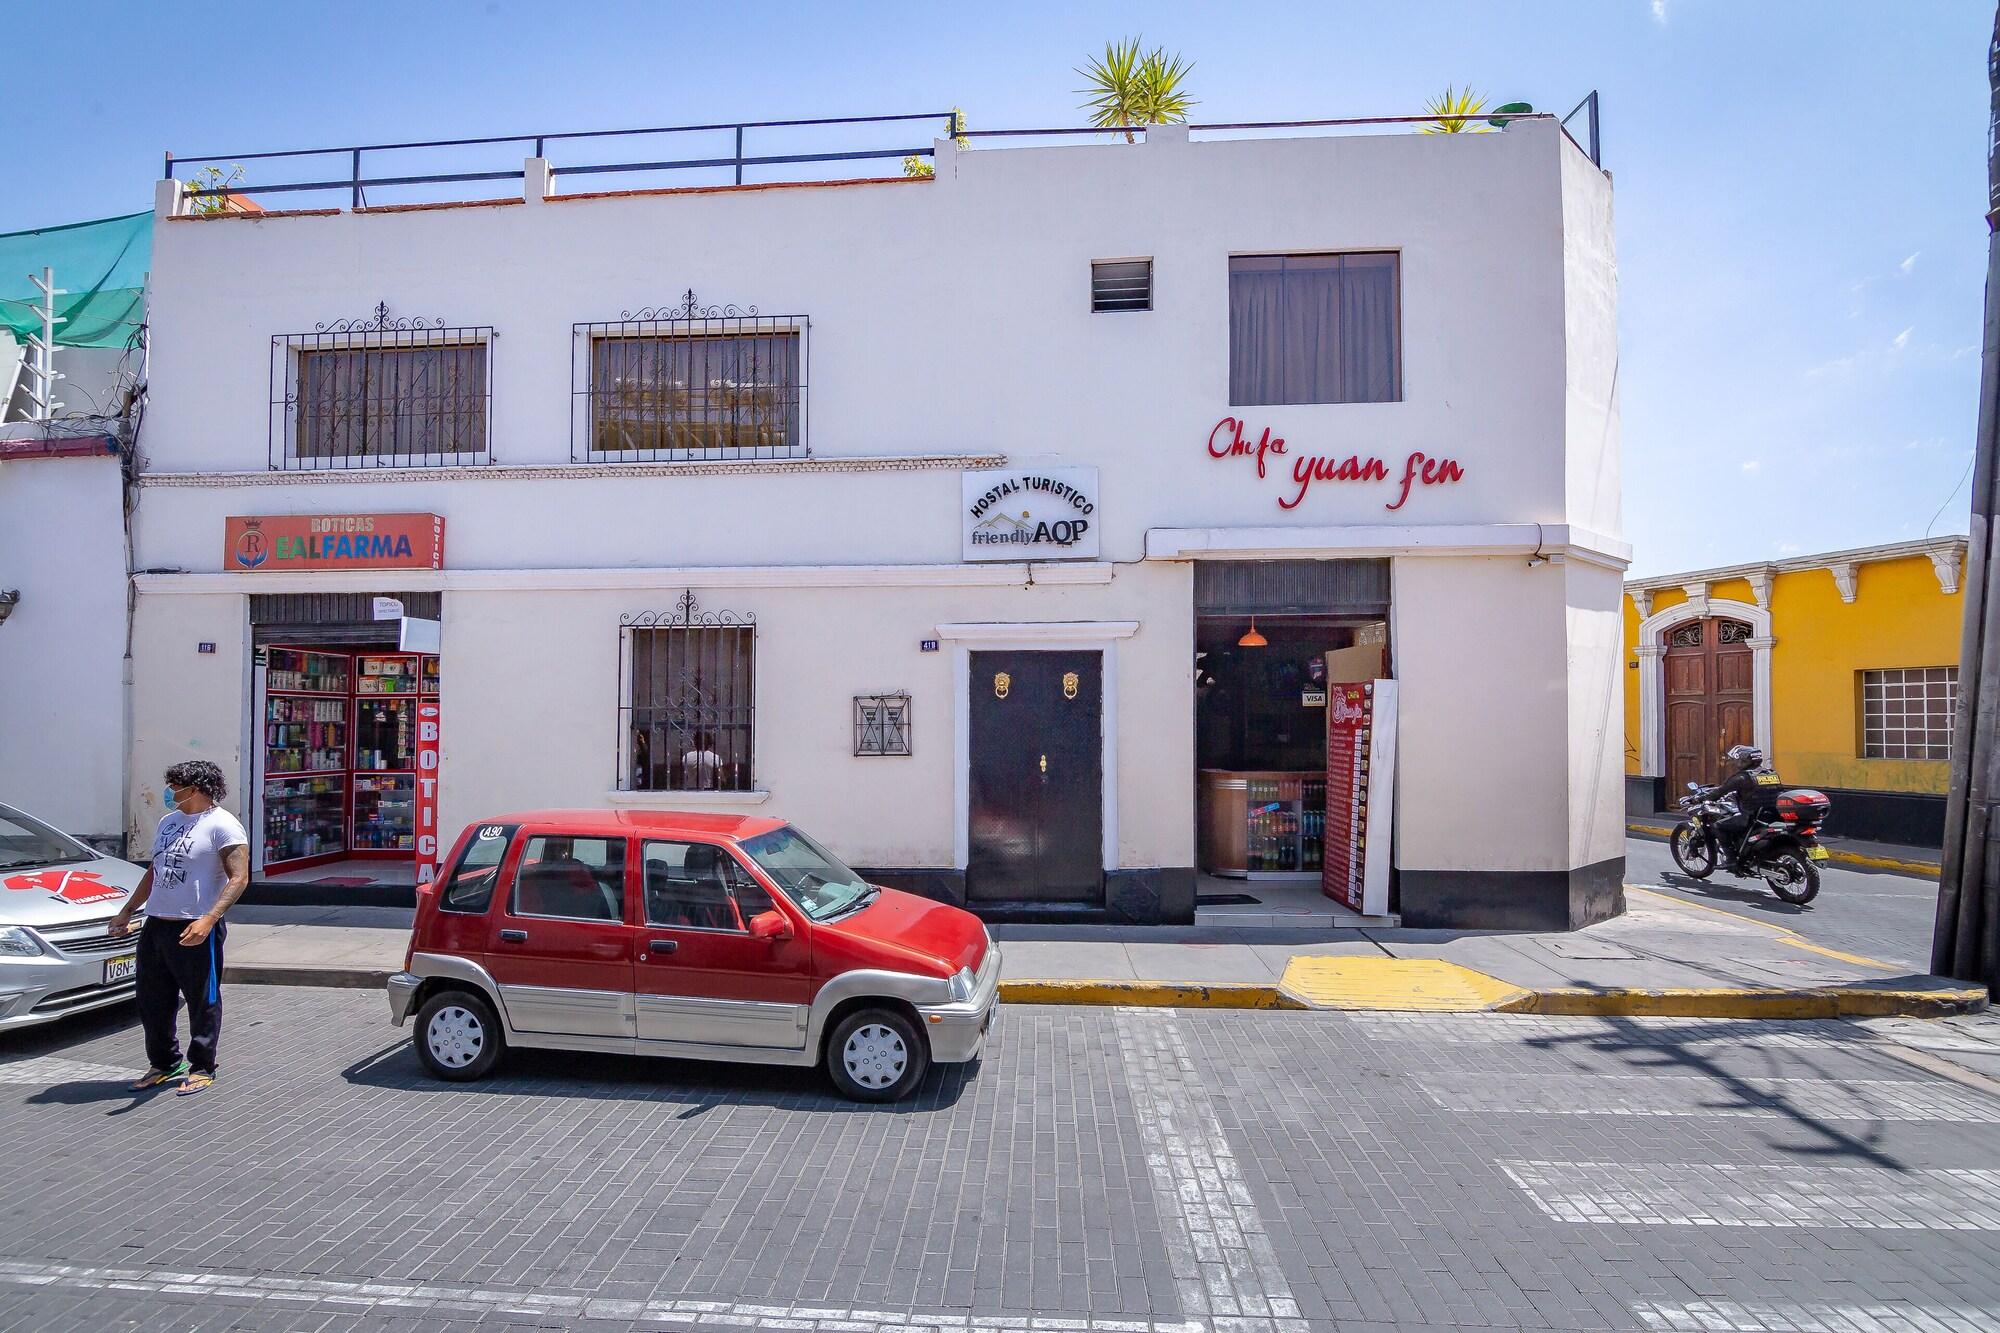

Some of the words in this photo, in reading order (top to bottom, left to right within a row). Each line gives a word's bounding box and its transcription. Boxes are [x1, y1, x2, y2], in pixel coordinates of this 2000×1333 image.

[970, 478, 1020, 519] HOSTAL
[1022, 476, 1094, 515] TURISTICO
[1278, 455, 1389, 510] yuan
[1385, 451, 1464, 510] fen
[311, 517, 374, 533] BOTICAS
[276, 534, 413, 560] EALFARMA
[432, 516, 441, 569] BOTICA
[417, 721, 438, 884] BOTICA
[483, 826, 503, 837] A90
[109, 960, 136, 979] V8N-
